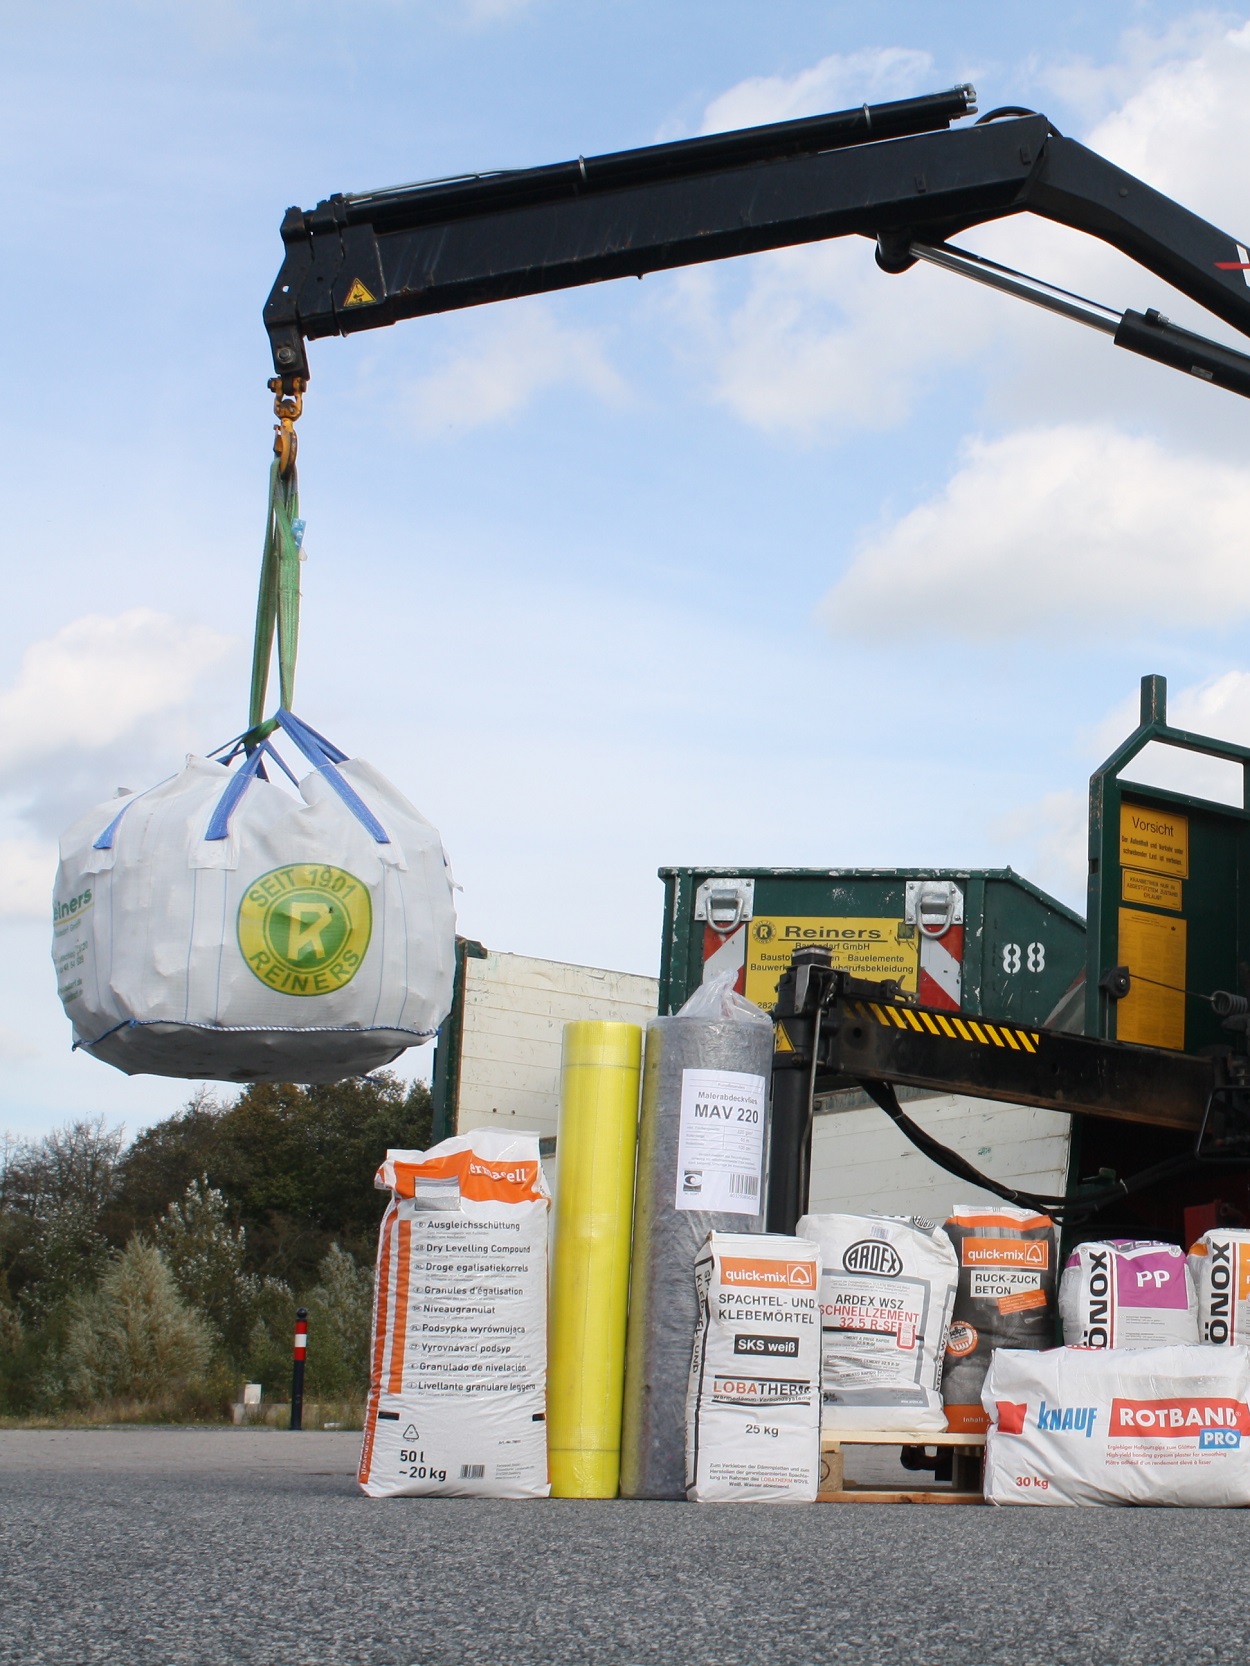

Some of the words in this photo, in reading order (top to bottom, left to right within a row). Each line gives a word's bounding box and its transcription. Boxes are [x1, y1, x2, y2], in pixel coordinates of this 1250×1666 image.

[1132, 816, 1174, 837] Vorsicht
[247, 866, 298, 908] SEIT
[309, 867, 358, 901] 1901
[287, 901, 333, 961] R
[785, 926, 882, 939] Reiners
[843, 943, 870, 951] GmbH
[848, 954, 904, 962] Bauelemente
[249, 949, 360, 992] REINERS
[694, 1103, 733, 1120] MAV
[737, 1107, 759, 1124] 220
[468, 1162, 528, 1183] ermacell
[427, 1220, 520, 1231] Ausgleichsschüttung
[426, 1243, 443, 1253] Dry
[446, 1244, 489, 1254] Levelling
[490, 1245, 531, 1255] Compound
[967, 1250, 1024, 1261] quick-mix
[848, 1244, 899, 1274] ARDEX
[425, 1262, 454, 1272] Droge
[456, 1263, 529, 1273] egalisatiekorrels
[725, 1269, 787, 1283] quick-mix
[975, 1273, 1039, 1285] RUCK-ZUCK
[1136, 1270, 1171, 1289] PP
[424, 1286, 467, 1295] Granules
[974, 1285, 1012, 1295] BETON
[718, 1293, 788, 1307] SPACHTEL-
[791, 1297, 815, 1309] UND
[835, 1293, 878, 1307] ARDEX
[879, 1297, 904, 1310] WSZ
[423, 1304, 495, 1315] Niveaugranulat
[718, 1309, 815, 1324] KLEBEMÖRTEL
[819, 1304, 920, 1323] SCHNELLZEMENT
[422, 1323, 468, 1334] Podsypka
[470, 1325, 525, 1336] wyrównująca
[421, 1342, 478, 1353] Vyrovnávací
[480, 1344, 512, 1355] podsyp
[738, 1338, 765, 1351] SKS
[768, 1341, 796, 1353] weiß
[419, 1362, 469, 1372] Granulado
[471, 1364, 483, 1372] de
[485, 1364, 527, 1373] nivelación
[418, 1382, 464, 1391] Livellante
[466, 1383, 509, 1393] granulare
[963, 1415, 984, 1424] Inhalt
[1119, 1407, 1238, 1429] ROTBAND
[745, 1424, 761, 1434] 25
[764, 1426, 779, 1438] kg
[1204, 1432, 1238, 1446] PRO
[400, 1450, 417, 1463] 50
[429, 1467, 447, 1482] kg
[1015, 1476, 1031, 1488] 30
[1034, 1476, 1050, 1490] kg
